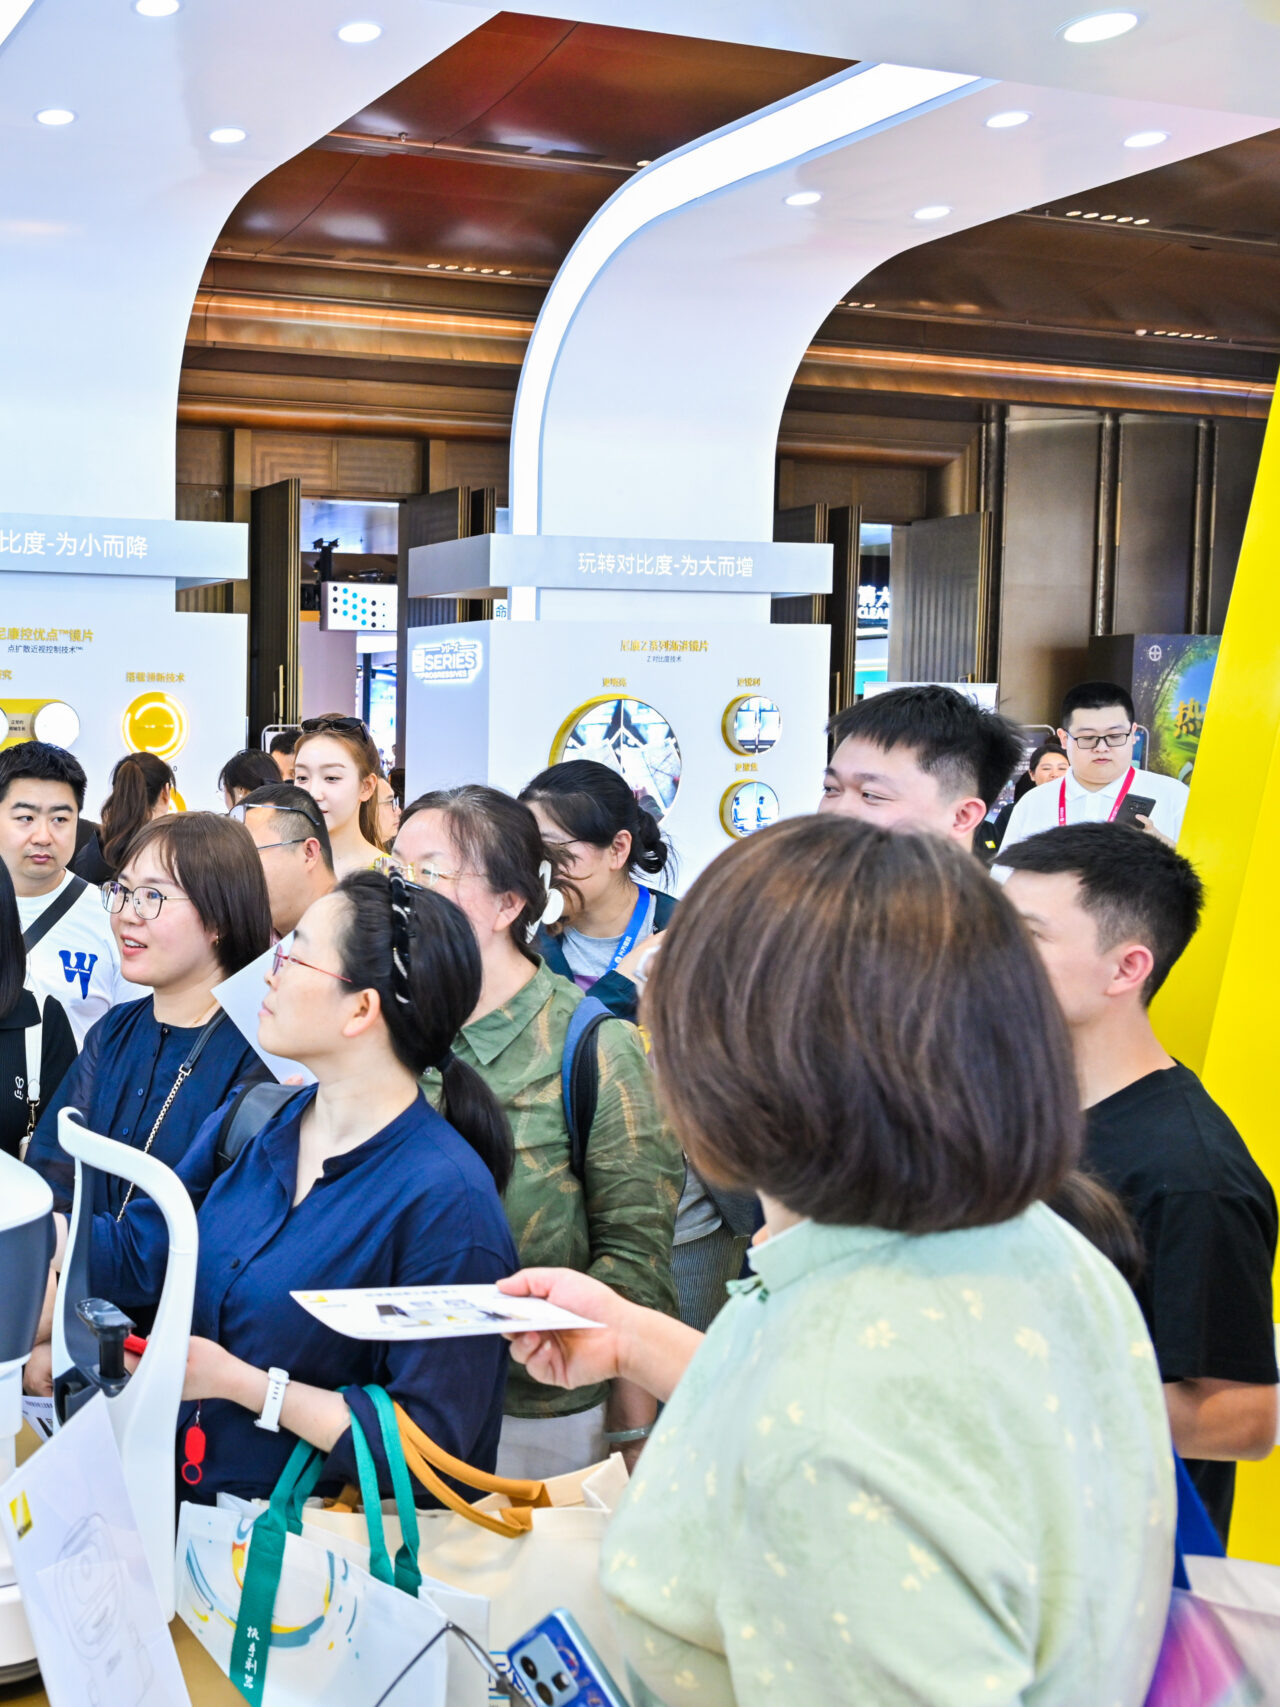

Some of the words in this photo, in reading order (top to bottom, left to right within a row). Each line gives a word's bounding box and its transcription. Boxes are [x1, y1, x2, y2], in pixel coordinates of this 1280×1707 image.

[578, 552, 754, 578] 玩转对比度-为大而增
[425, 651, 477, 672] SERIES
